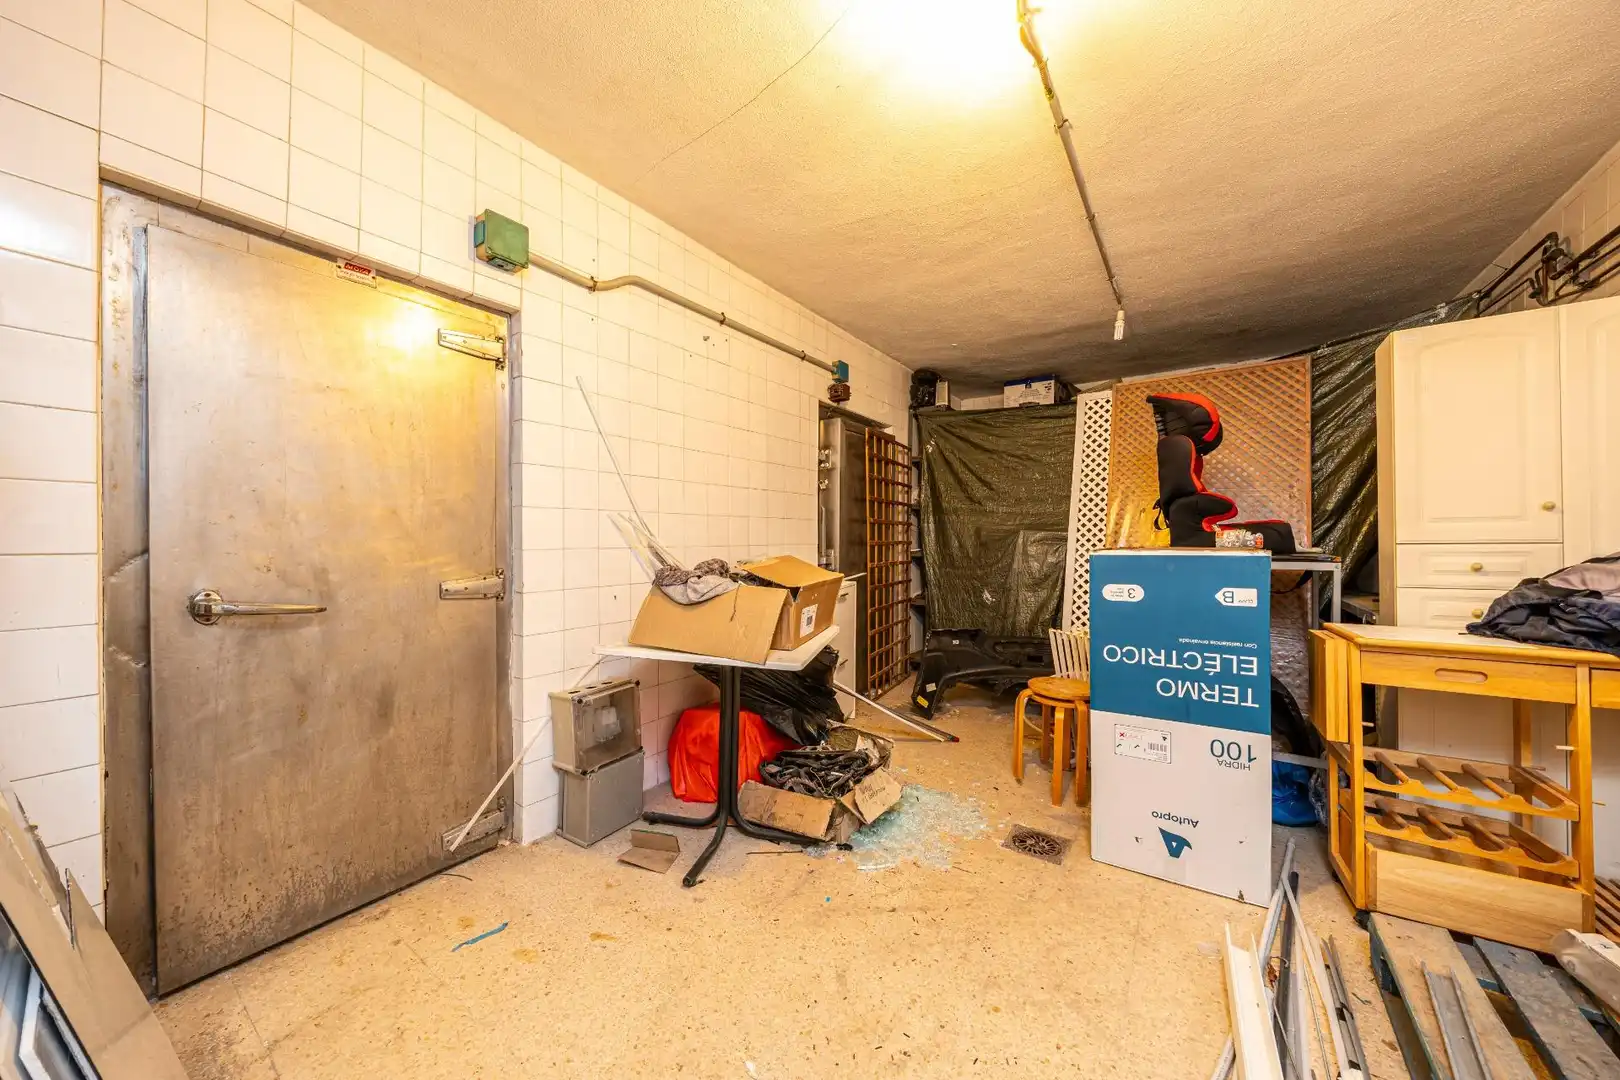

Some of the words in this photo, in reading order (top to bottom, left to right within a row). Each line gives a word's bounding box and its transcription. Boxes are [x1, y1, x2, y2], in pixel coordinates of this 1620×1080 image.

[1127, 588, 1136, 599] 3
[1222, 590, 1235, 604] B
[1178, 637, 1209, 645] envainada
[1209, 640, 1243, 648] resistencia
[1103, 644, 1258, 676] ELÉCTRICO
[1156, 678, 1259, 708] TERMO
[1210, 739, 1257, 763] 100
[1216, 758, 1251, 771] HIDRA
[1151, 810, 1199, 828] Autopro
